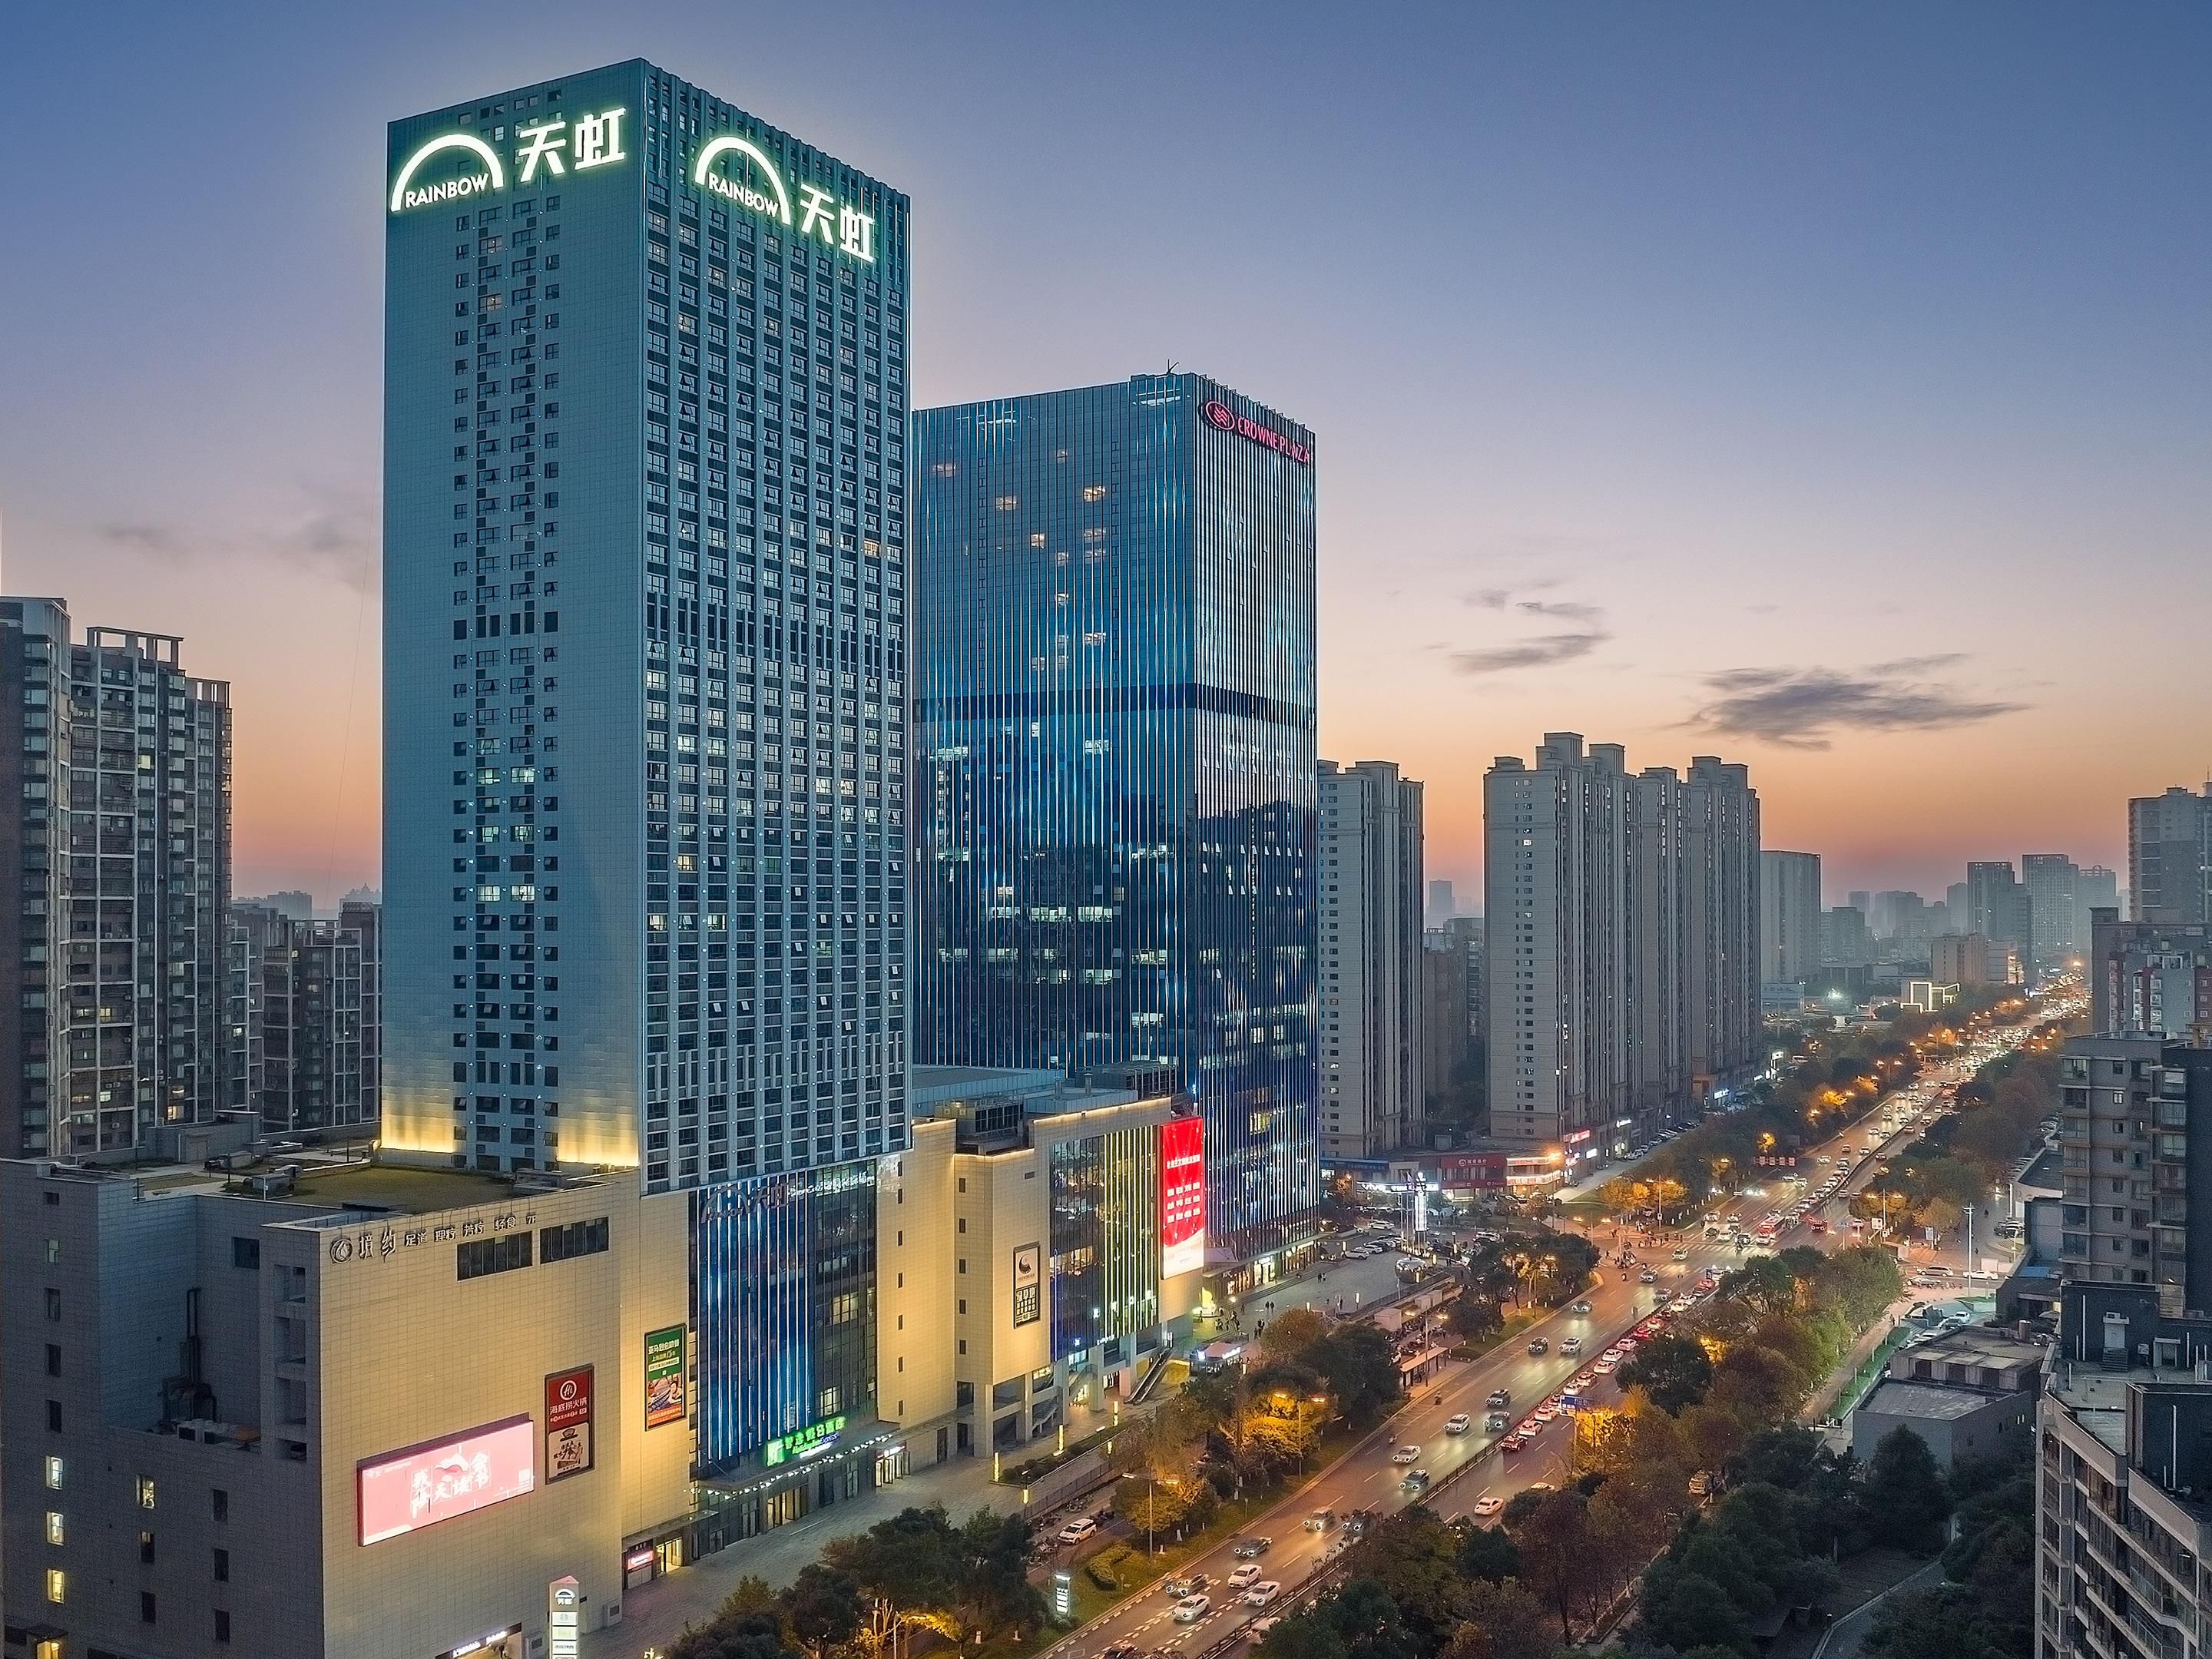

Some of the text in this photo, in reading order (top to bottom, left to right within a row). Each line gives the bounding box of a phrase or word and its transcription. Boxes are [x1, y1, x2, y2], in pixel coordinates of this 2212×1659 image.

[518, 107, 626, 183] 天虹
[404, 172, 489, 208] RAINBOW
[708, 171, 779, 218] RAINBOW
[800, 183, 875, 263] 天虹
[1237, 416, 1310, 465] CROWNE PLAZA
[405, 1232, 428, 1247] 足道
[434, 1228, 456, 1243] 理疗
[495, 1217, 516, 1232] 轻食
[549, 1396, 588, 1416] 海底捞火锅
[563, 1384, 573, 1397] Hi
